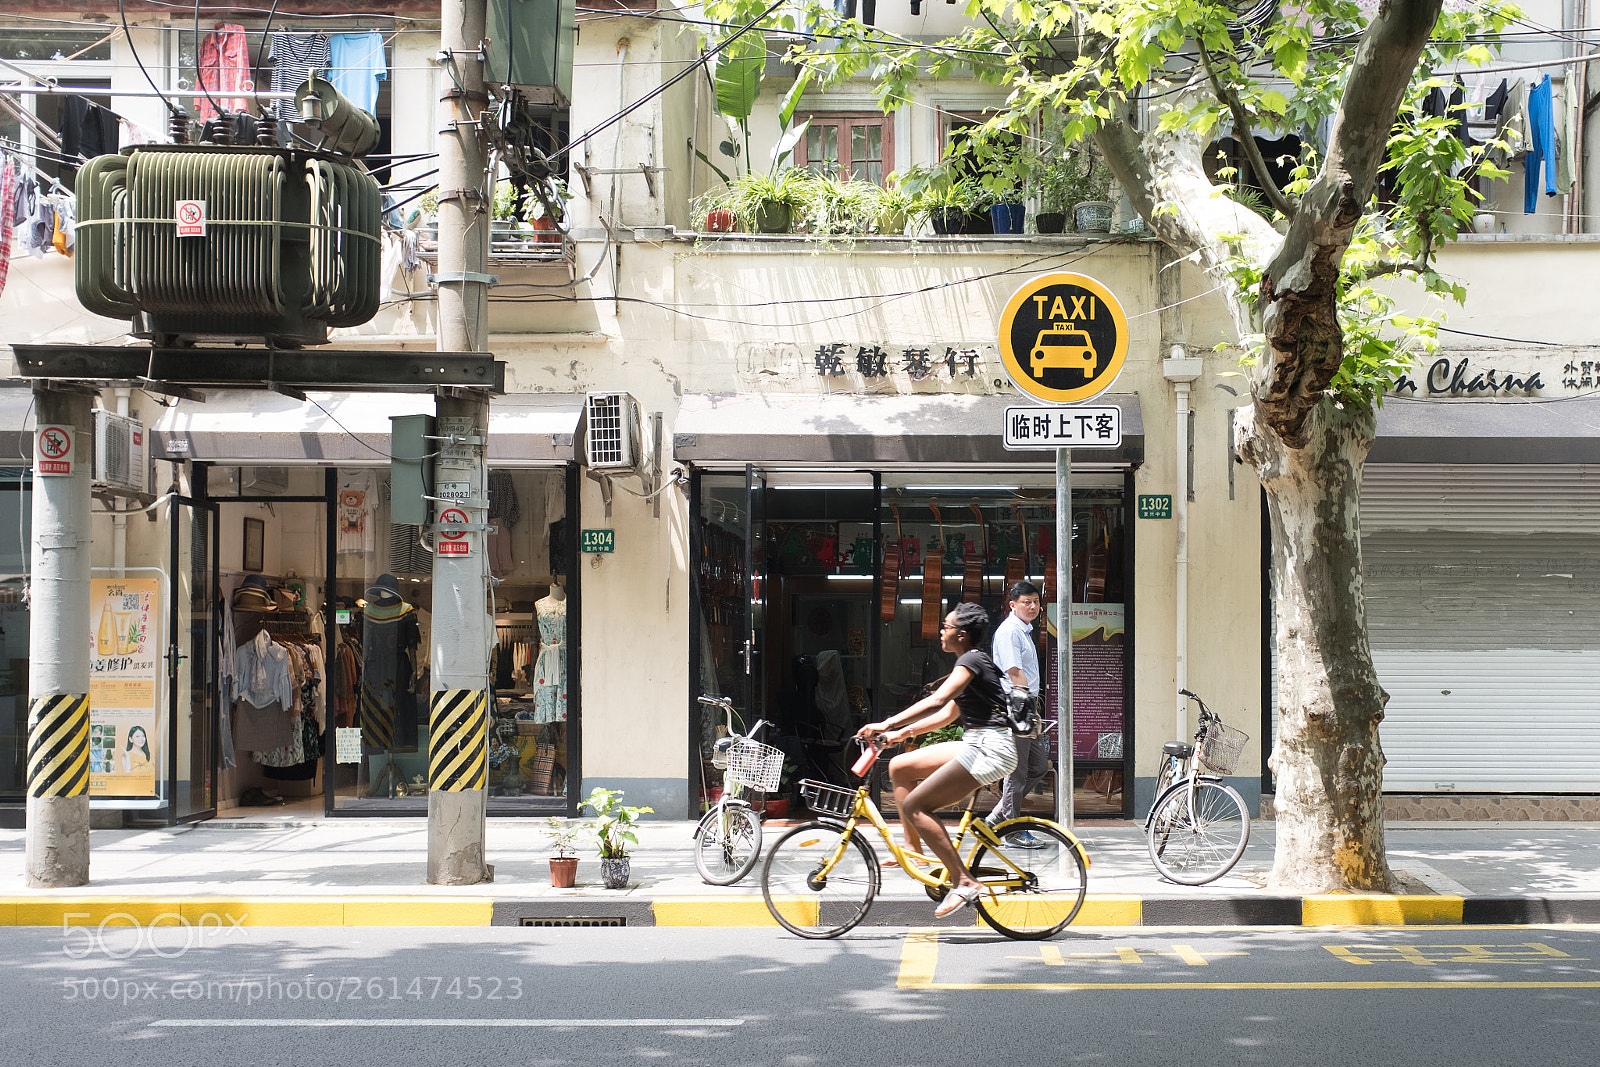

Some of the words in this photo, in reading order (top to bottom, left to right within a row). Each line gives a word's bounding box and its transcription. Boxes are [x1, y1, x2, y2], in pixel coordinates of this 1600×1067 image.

[1033, 295, 1096, 320] TAXI
[1055, 323, 1073, 331] TAXI
[1012, 413, 1114, 440] 临时上下客
[1141, 497, 1169, 510] 1302
[584, 532, 613, 545] 1304
